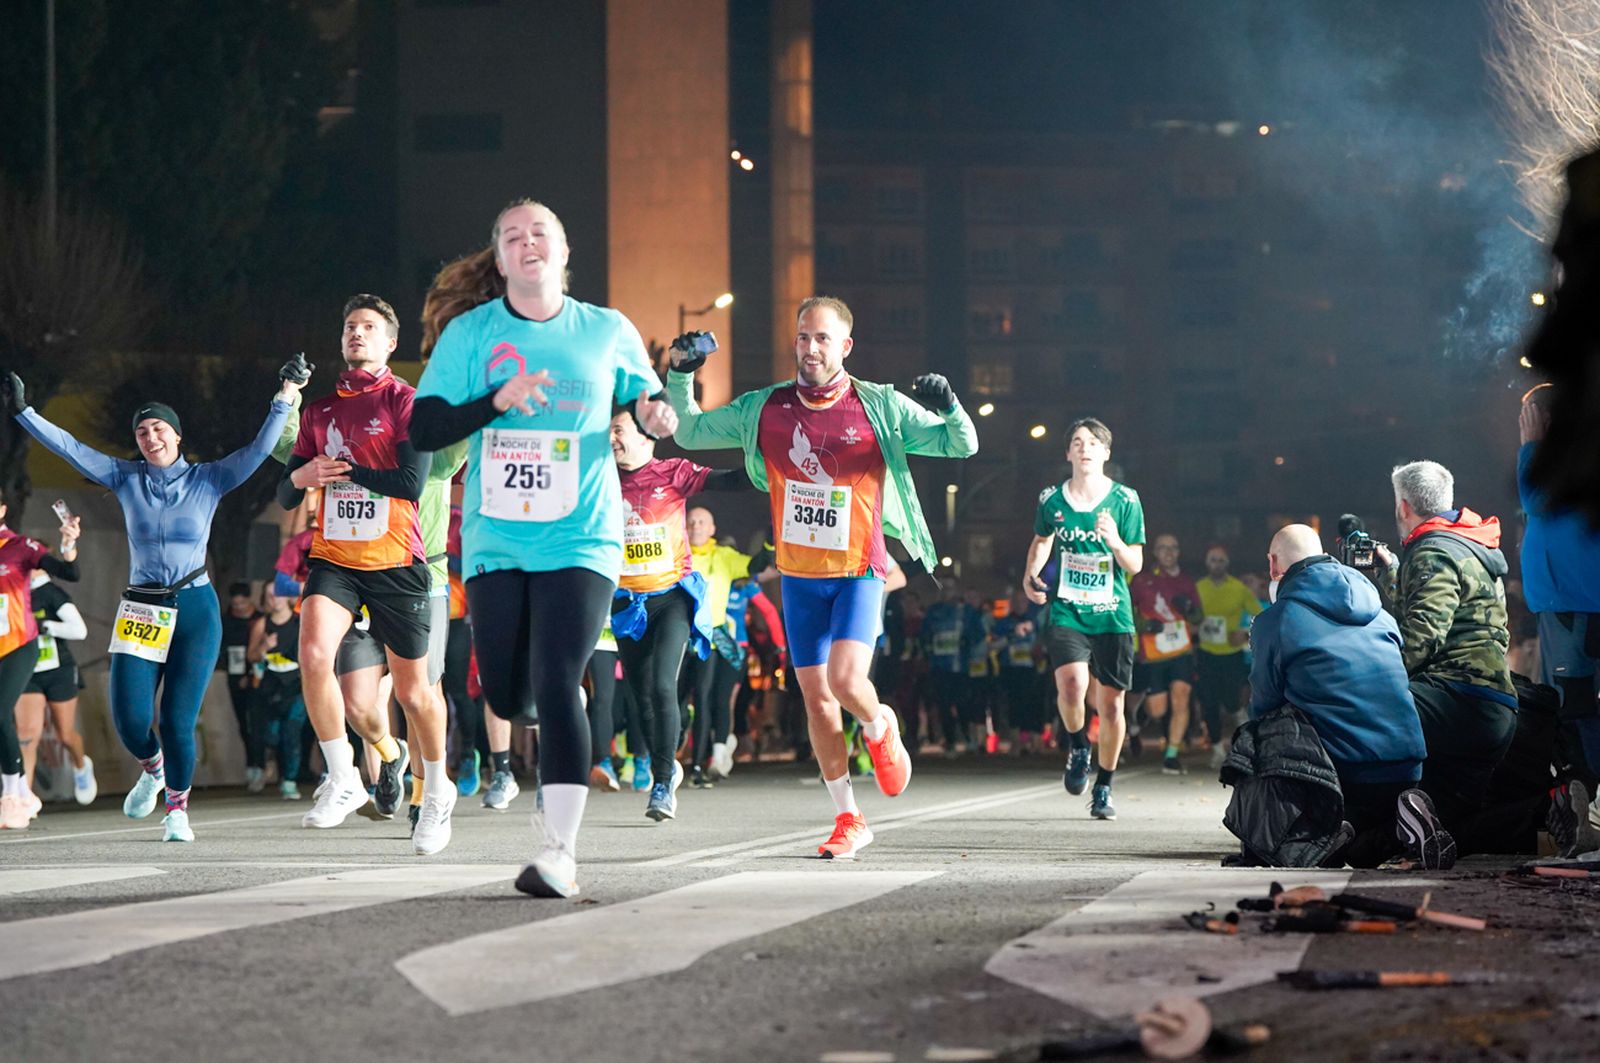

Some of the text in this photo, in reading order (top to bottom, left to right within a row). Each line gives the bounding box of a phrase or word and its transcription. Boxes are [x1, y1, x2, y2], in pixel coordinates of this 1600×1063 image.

[500, 441, 541, 450] NOCHE DE
[491, 450, 507, 460] SAN
[801, 457, 819, 476] 43
[504, 463, 552, 490] 255
[337, 500, 376, 520] 6673
[794, 504, 838, 528] 3346
[1055, 526, 1102, 542] Kubot
[626, 542, 663, 559] 5088
[1068, 570, 1106, 587] 13624
[123, 620, 161, 642] 3527
